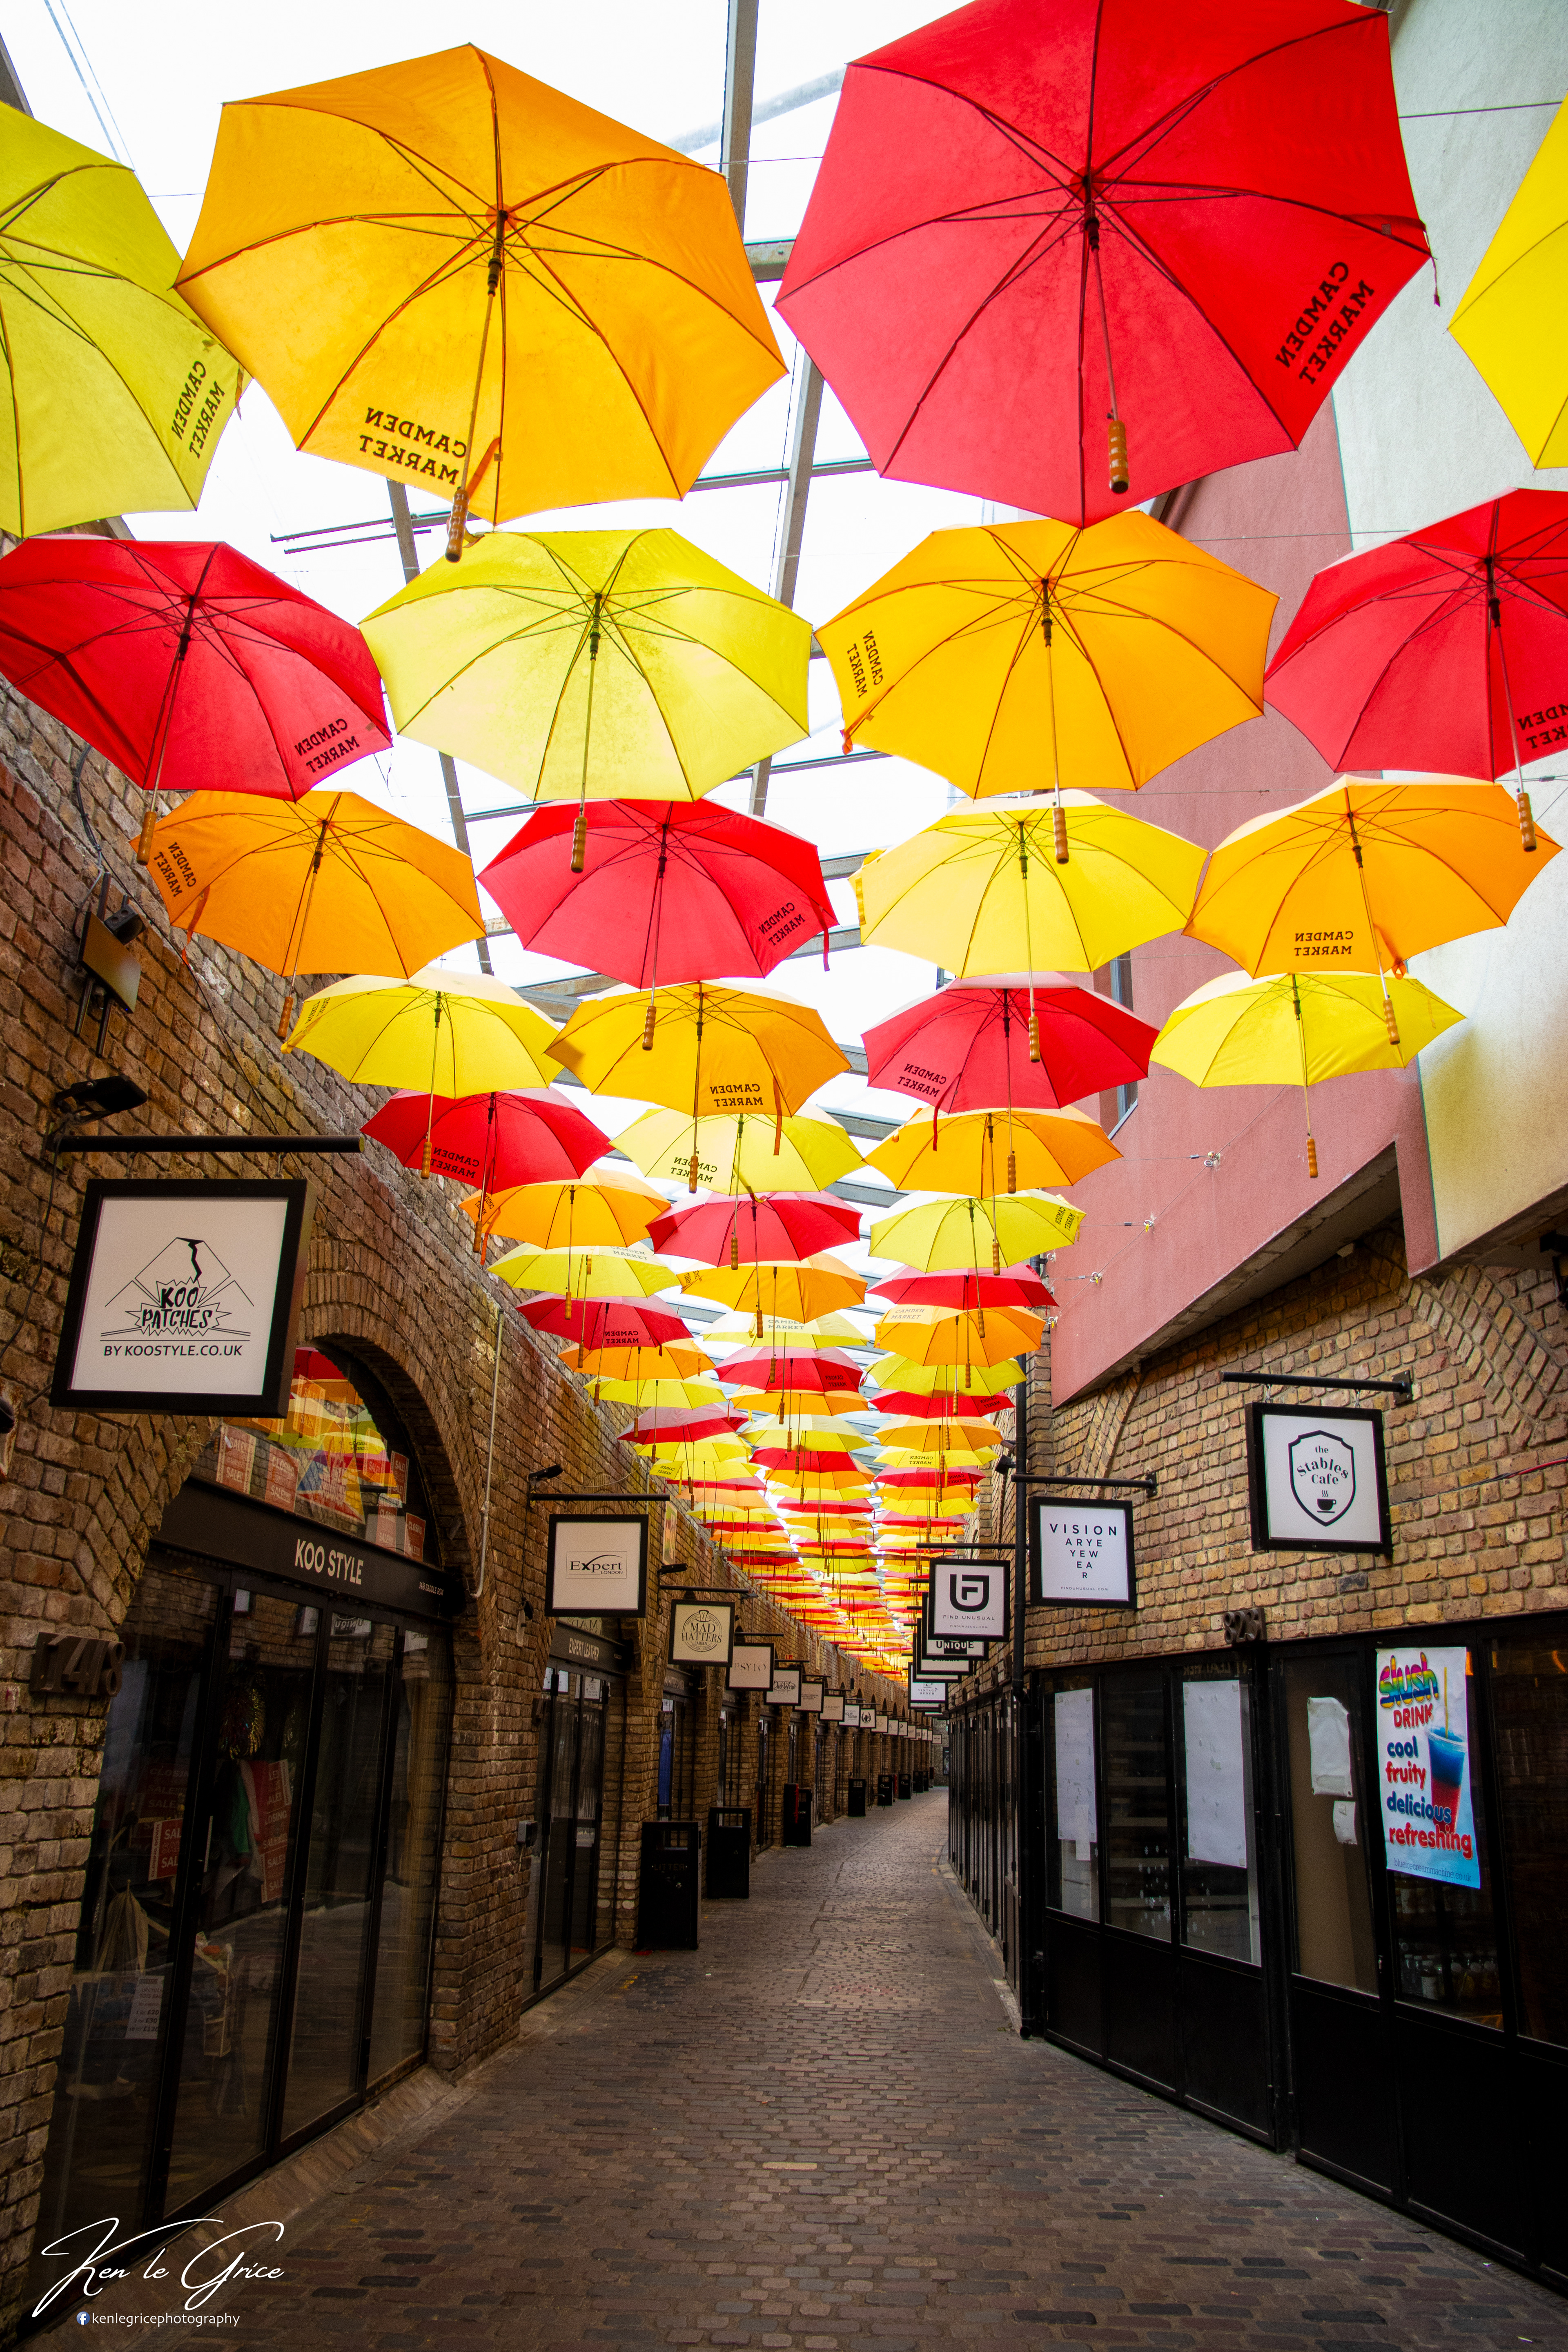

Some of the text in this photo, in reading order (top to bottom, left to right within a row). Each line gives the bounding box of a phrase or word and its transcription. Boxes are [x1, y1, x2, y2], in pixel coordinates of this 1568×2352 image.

[613, 1250, 647, 1260] MARKET
[162, 1287, 199, 1308] KOO
[142, 1309, 213, 1329] PATCHES
[104, 1345, 243, 1356] BY KOOSTYLE.CO.UK
[272, 1456, 294, 1477] CLOSING
[1297, 1457, 1348, 1479] Stables
[1311, 1473, 1339, 1485] Cafe
[1049, 1523, 1117, 1536] VISION
[1065, 1538, 1102, 1546] ARYE
[295, 1539, 363, 1585] KOO STYLE
[570, 1559, 623, 1572] Expert
[425, 1584, 437, 1594] SADDLE
[682, 1632, 722, 1643] HATTERS
[690, 1622, 715, 1633] MAD
[569, 1638, 599, 1661] EXPERT LEATHER
[1393, 1703, 1432, 1728] DRINK
[1387, 1735, 1419, 1758] cool
[1385, 1761, 1426, 1791] fruity
[1387, 1791, 1452, 1824] delicious
[1389, 1822, 1473, 1860] refreshing
[1394, 1858, 1472, 1882] blueicecreammachine.co.uk
